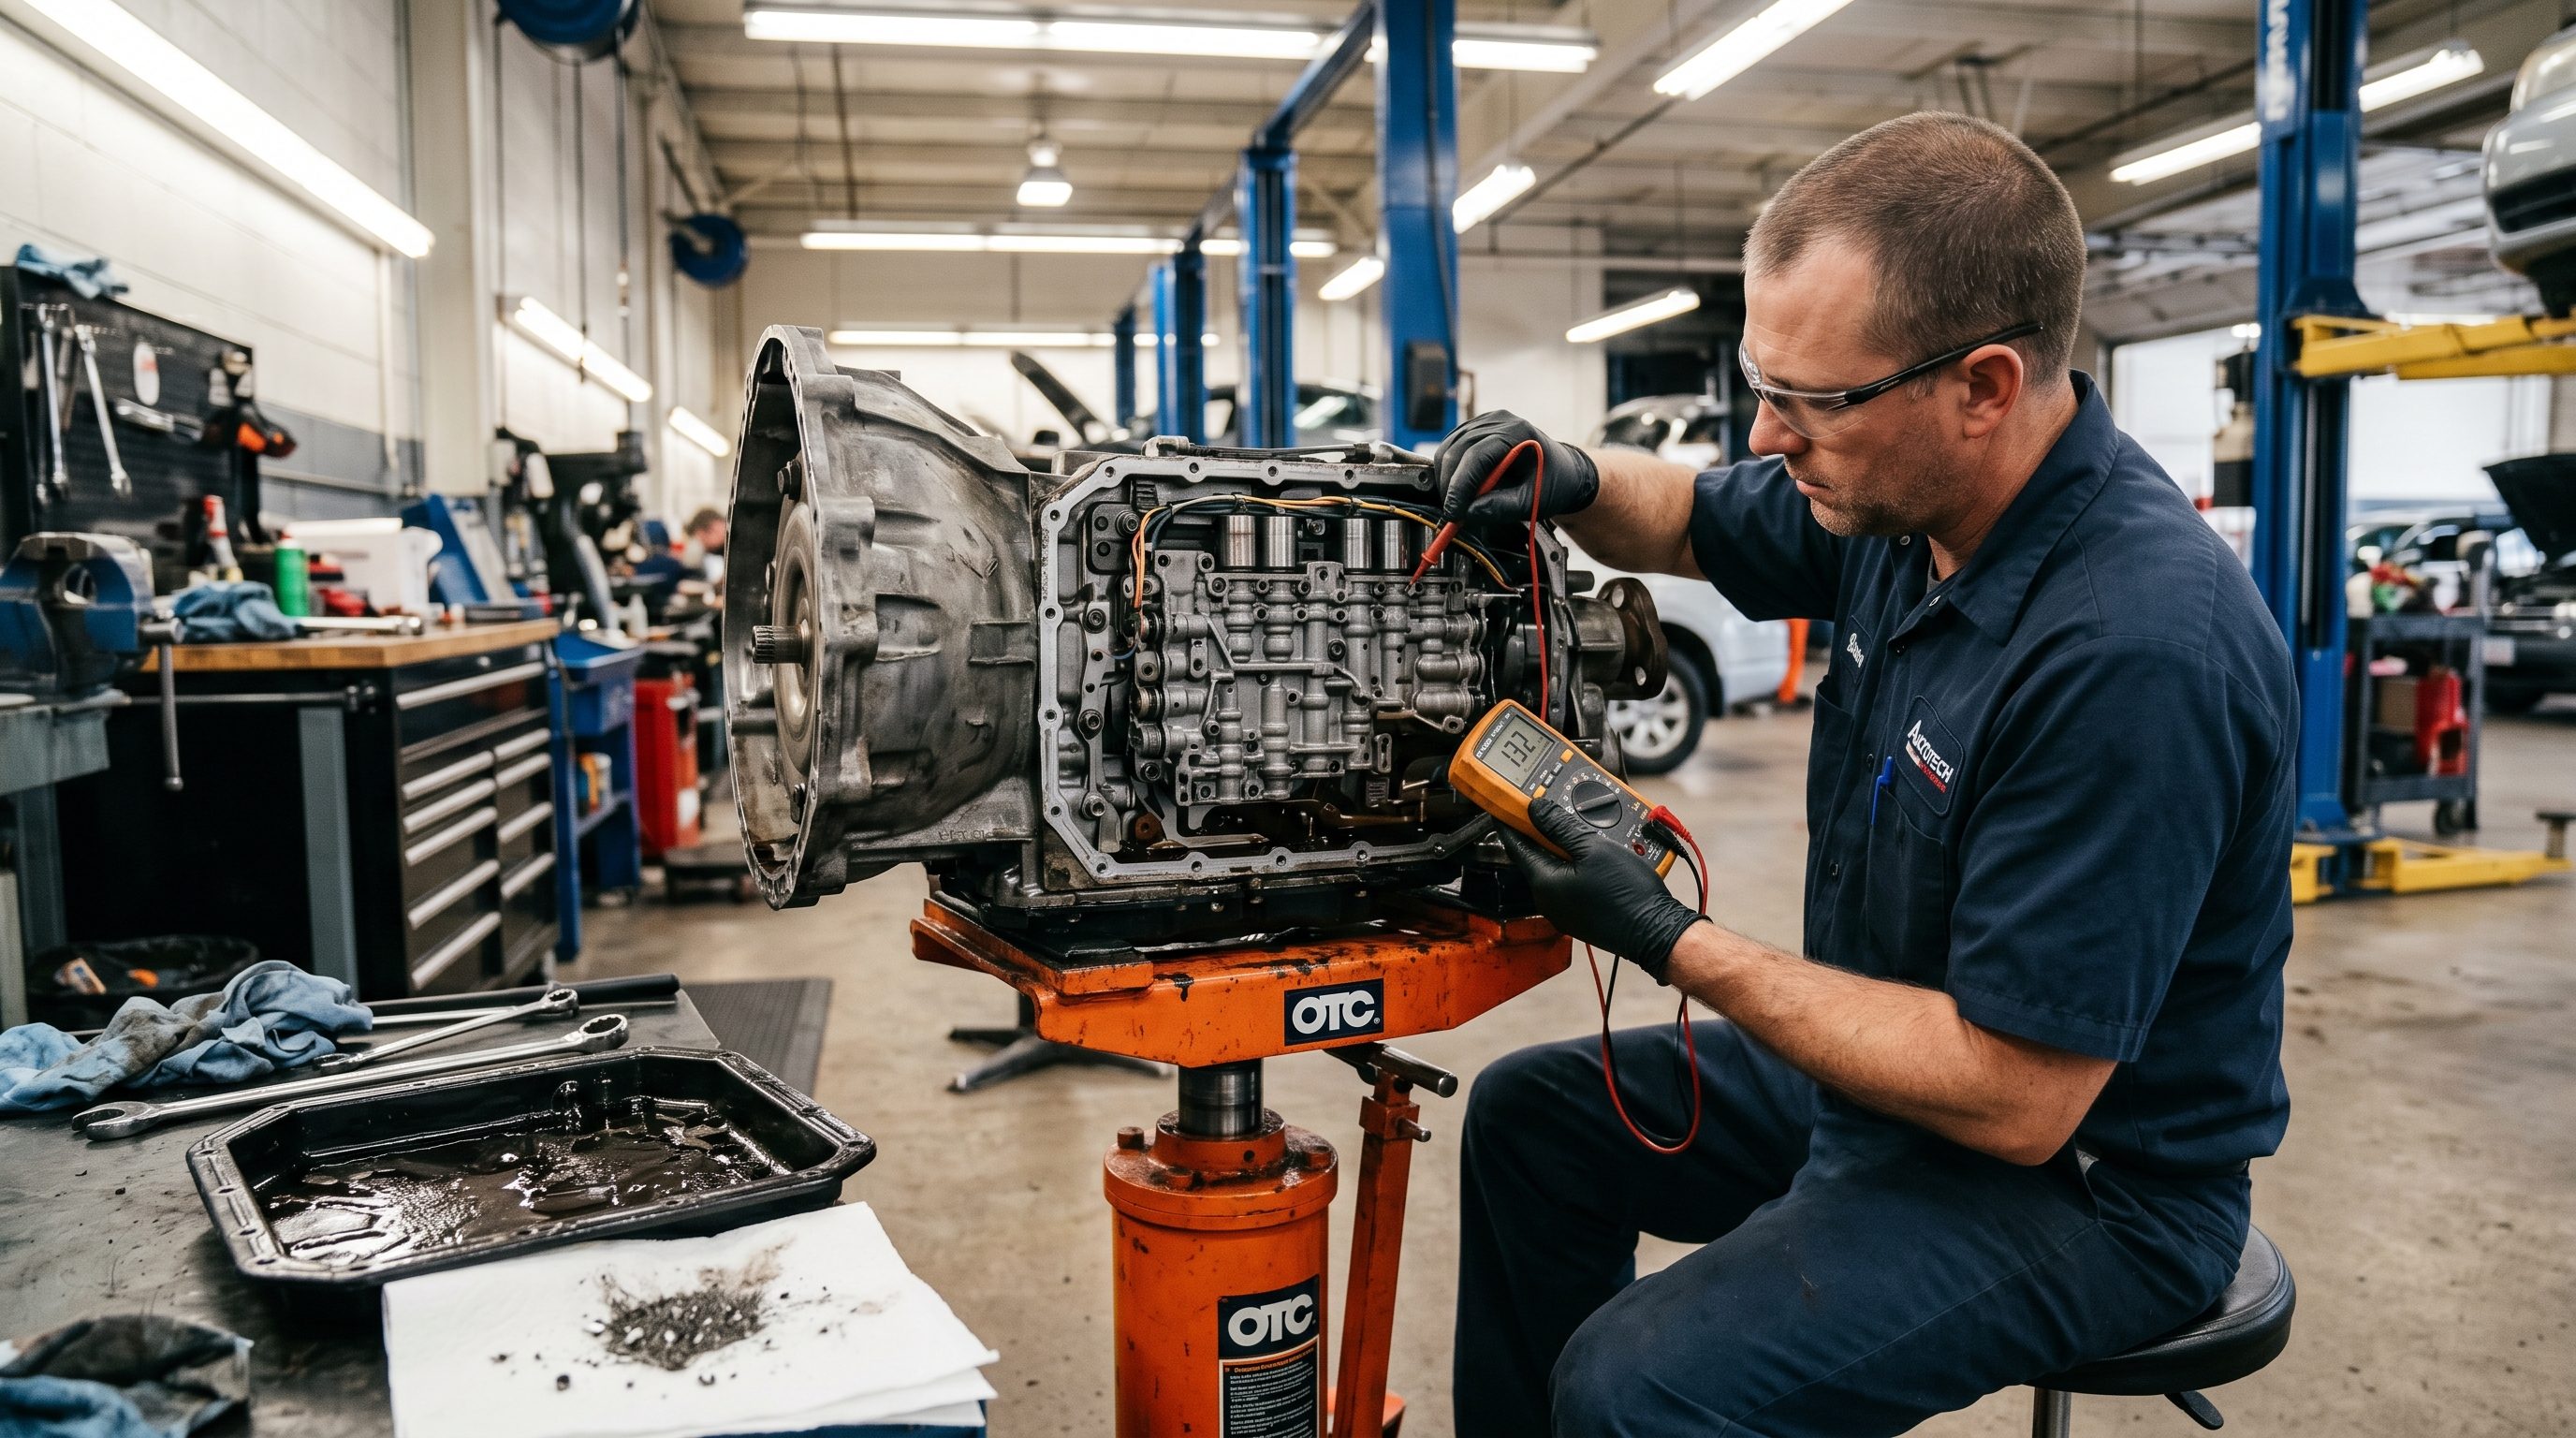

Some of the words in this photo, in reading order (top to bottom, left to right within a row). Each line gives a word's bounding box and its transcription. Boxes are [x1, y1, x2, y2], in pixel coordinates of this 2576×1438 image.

[1501, 730, 1536, 768] 132
[1292, 990, 1375, 1034] OTC
[1227, 1293, 1314, 1347] OTC
